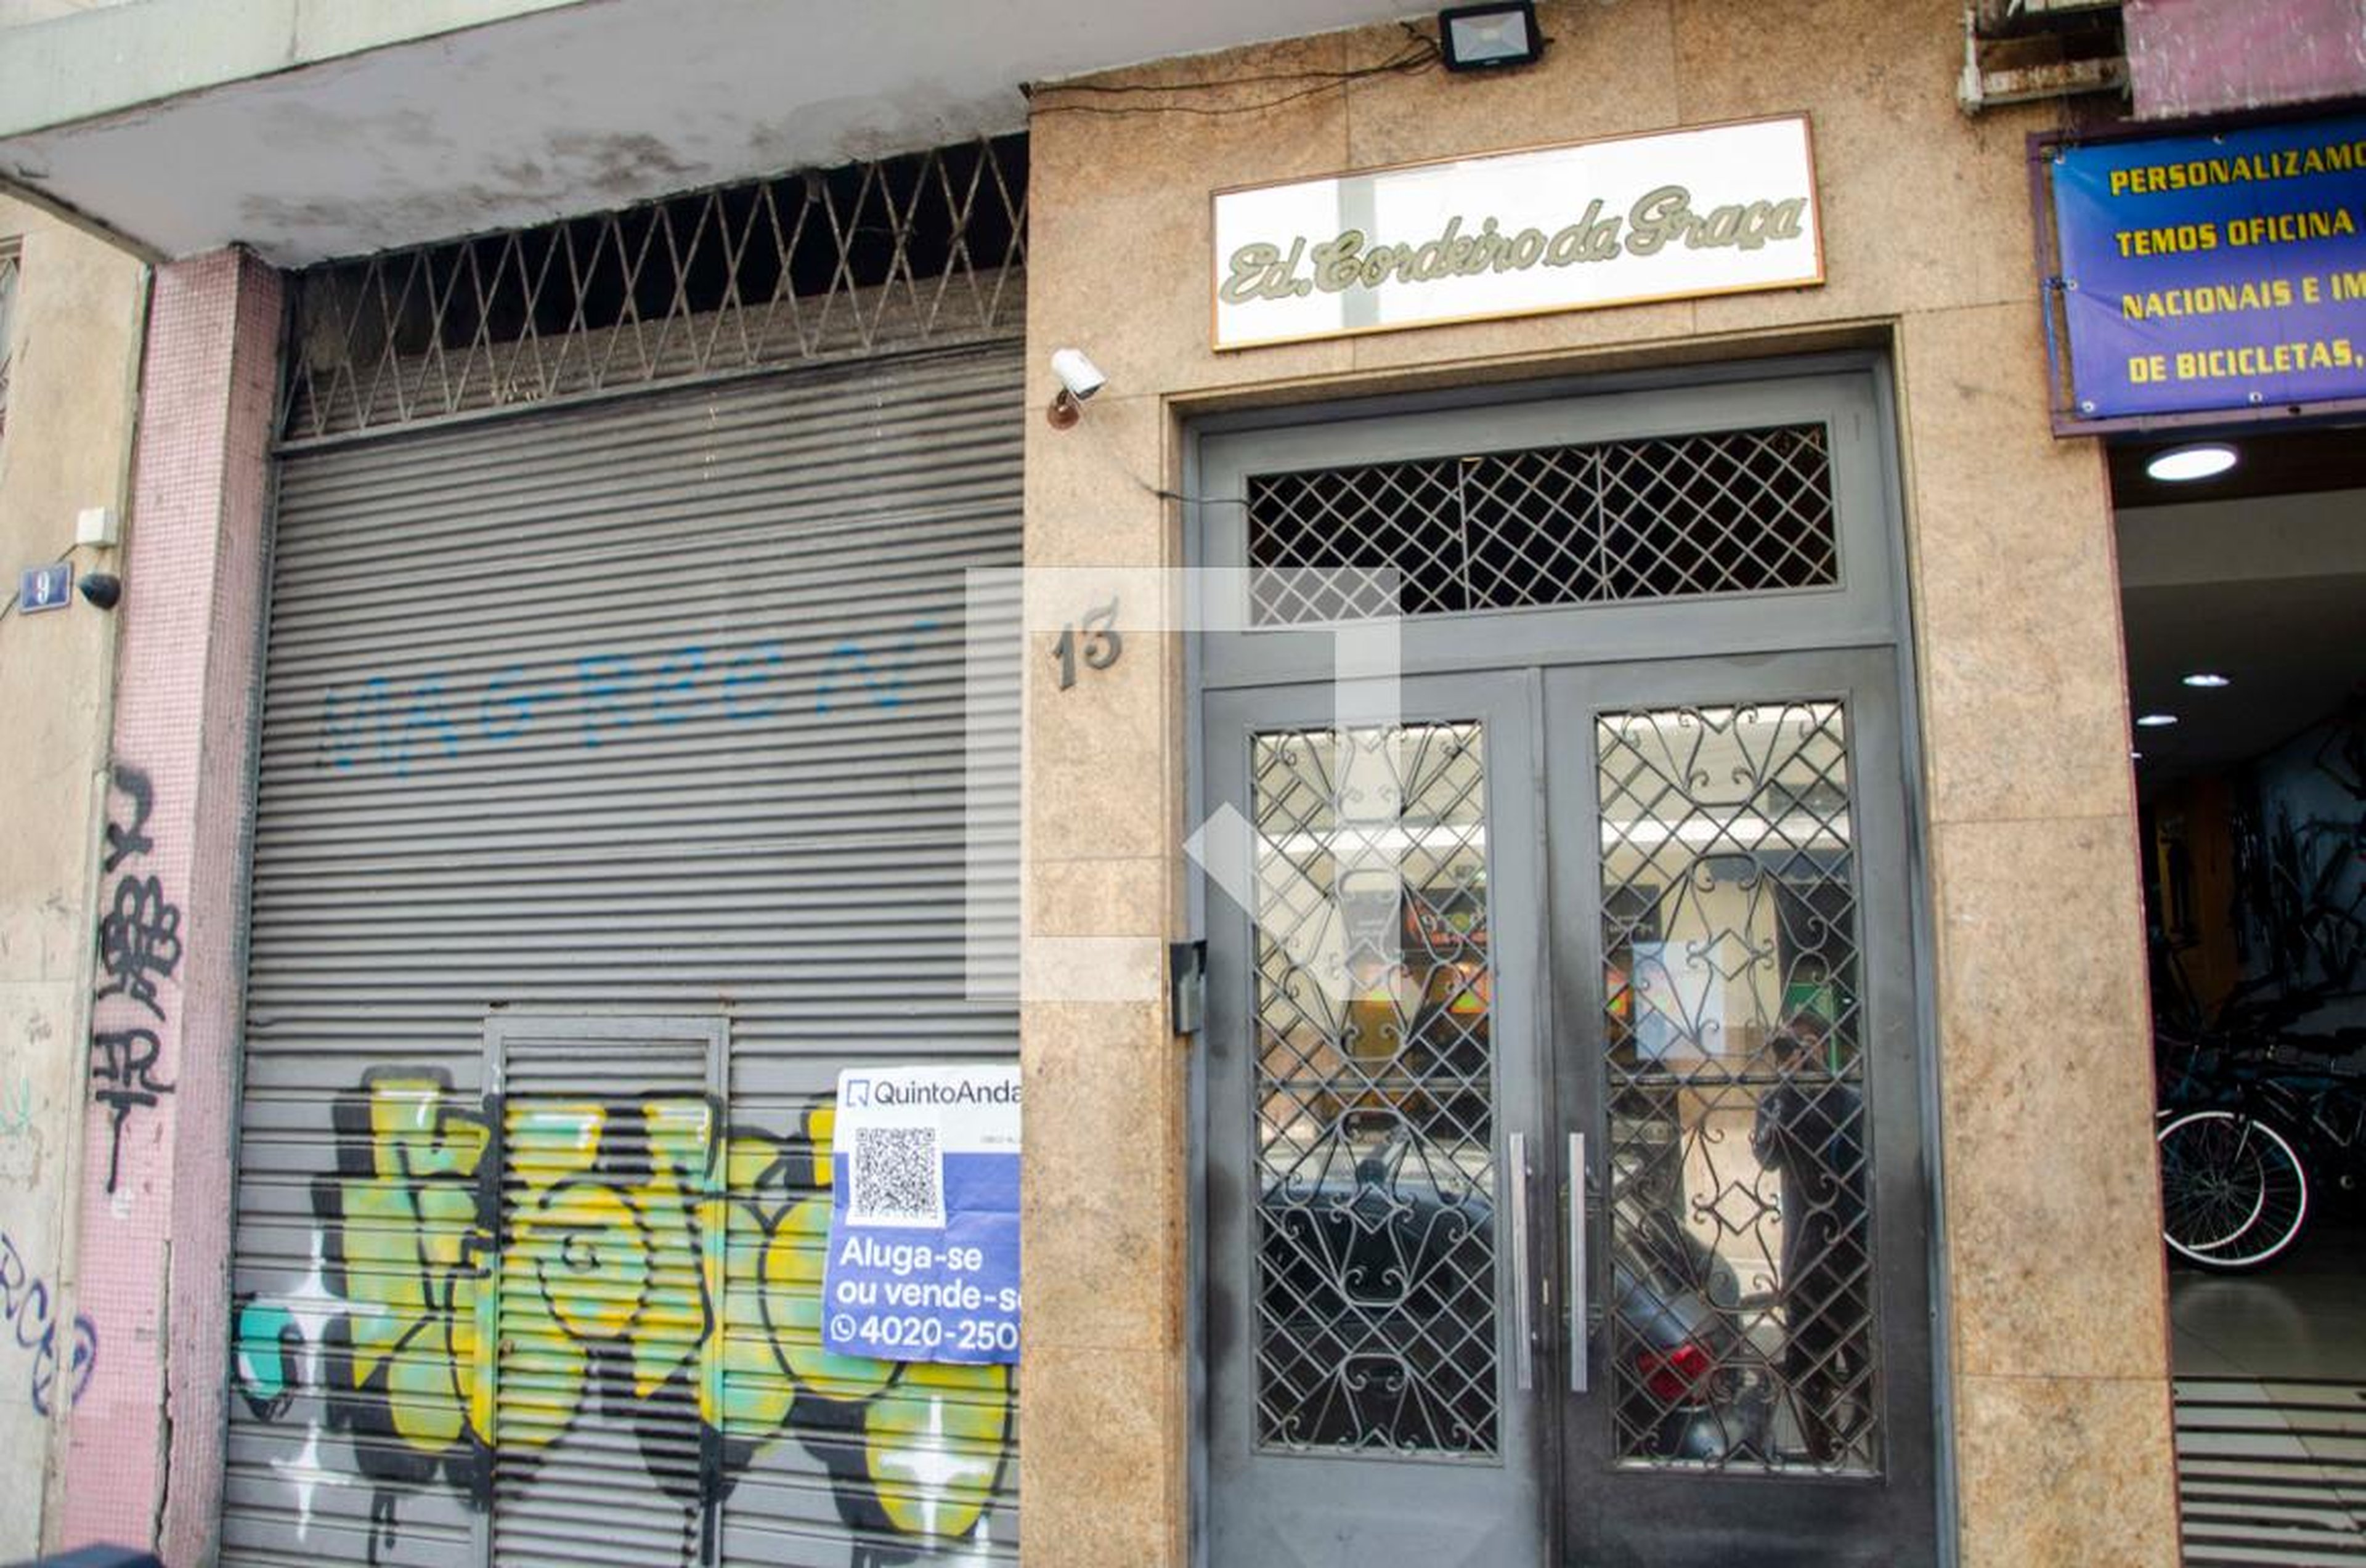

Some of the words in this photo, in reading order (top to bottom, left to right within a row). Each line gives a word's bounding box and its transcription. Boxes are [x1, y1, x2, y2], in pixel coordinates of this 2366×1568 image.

[2110, 141, 2366, 196] PERSONALIZAMO
[1220, 237, 1312, 305] Ed.
[1311, 215, 1548, 293] Cordeiro
[1542, 198, 1622, 268] da
[2116, 223, 2216, 257] TEMOS
[2228, 208, 2354, 246] OFICINA
[2122, 280, 2291, 320] NACIONAIS
[2302, 277, 2320, 304] E
[2331, 271, 2366, 301] IM
[2129, 355, 2166, 384] DE
[2177, 339, 2364, 380] BICICLETAS,
[1051, 595, 1122, 691] 13
[874, 1079, 1022, 1105] QuintoAnda
[839, 1237, 983, 1275] Aluga-se
[836, 1280, 883, 1304] ou
[885, 1278, 1022, 1312] vende-s
[860, 1316, 1021, 1351] 4020-250
